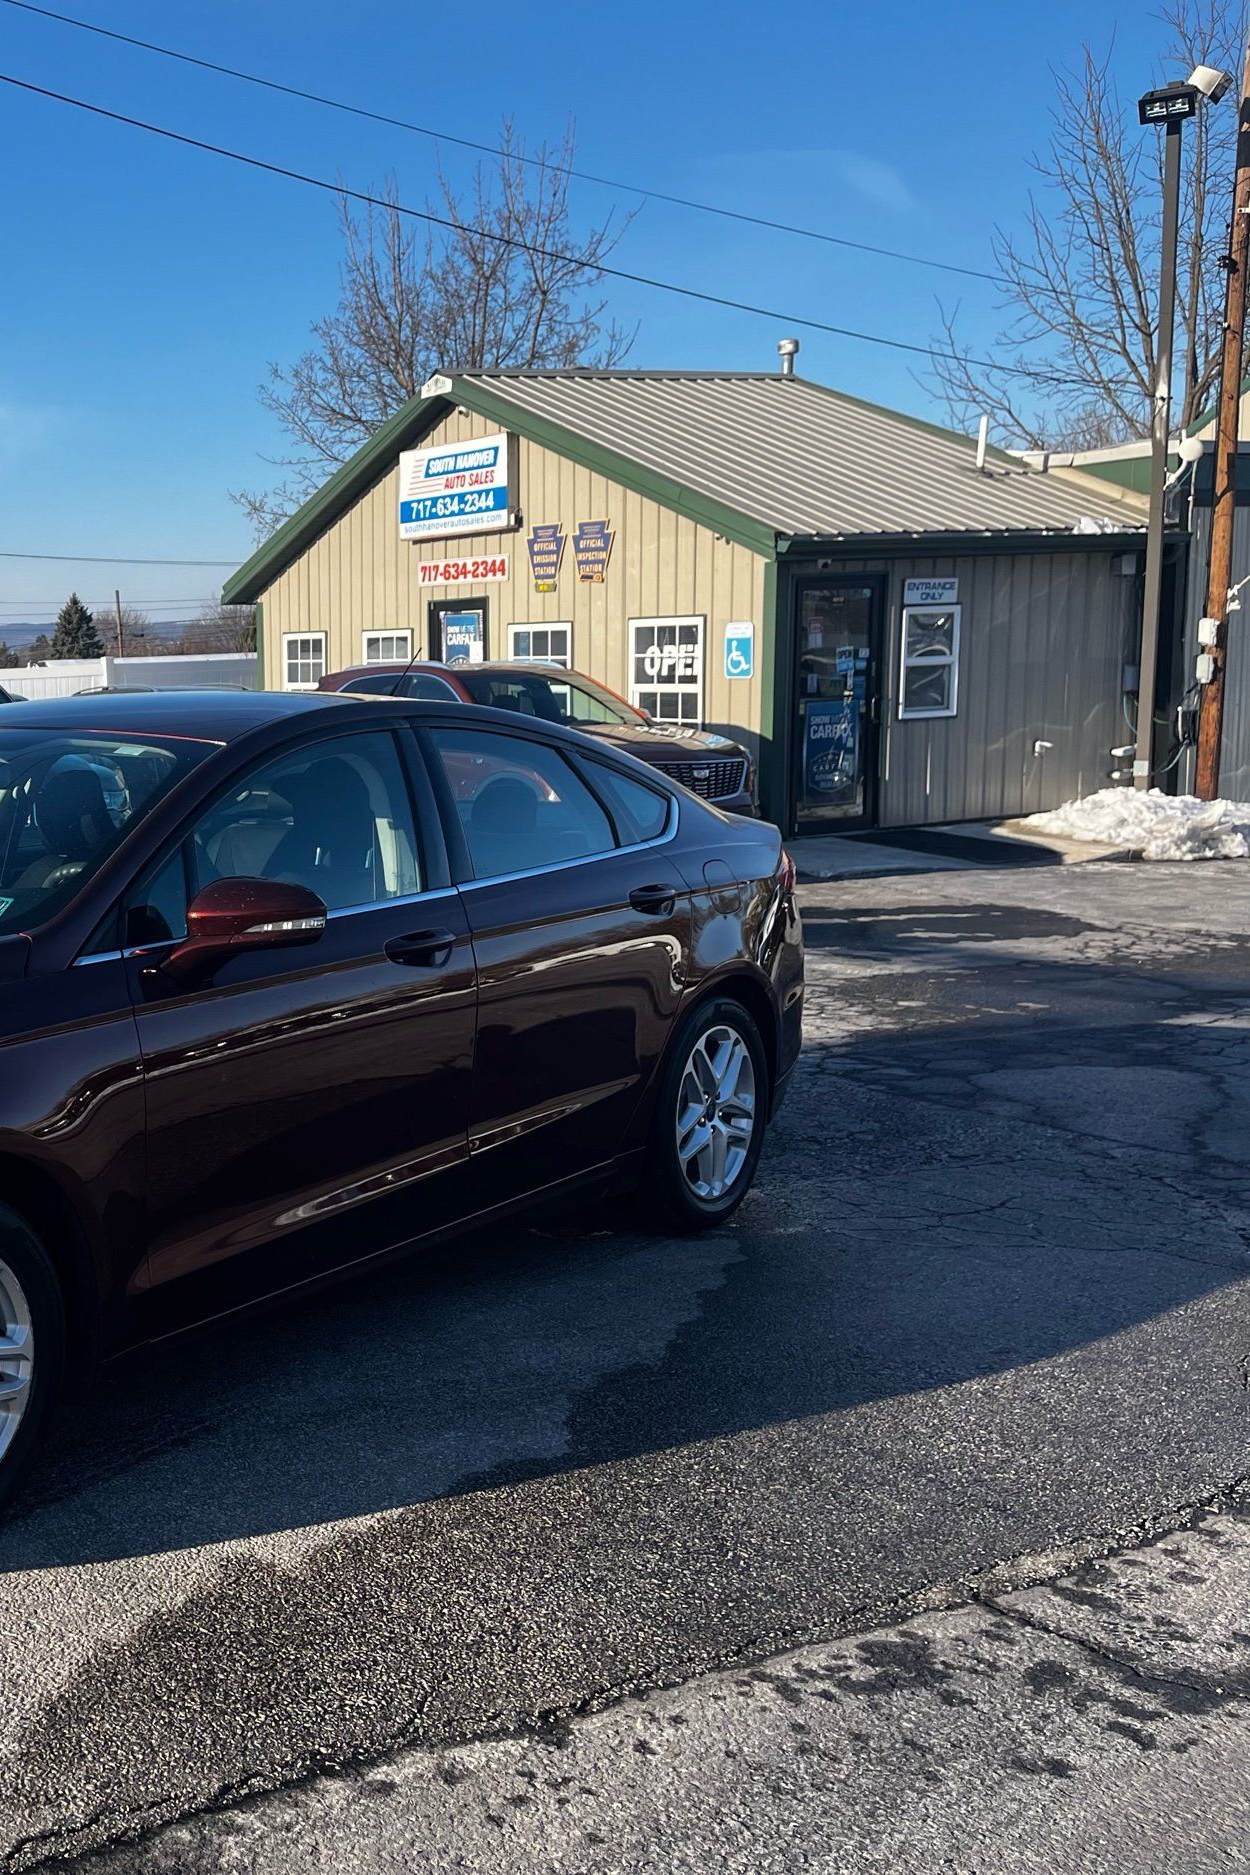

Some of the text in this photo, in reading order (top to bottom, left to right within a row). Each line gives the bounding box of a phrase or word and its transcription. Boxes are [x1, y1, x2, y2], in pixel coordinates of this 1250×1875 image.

[428, 449, 495, 475] SOUTH HANOVER
[444, 469, 495, 490] AUTO SALES
[410, 490, 495, 520] 717-634-2344
[404, 513, 502, 534] southhanoverautosales.com
[533, 541, 557, 552] OFFICIAL
[579, 538, 604, 549] OFFICIAL
[420, 558, 506, 583] 717-634-2344
[907, 581, 956, 591] ENTRANCE
[920, 592, 944, 601] ONLY
[446, 633, 476, 646] CARFAX
